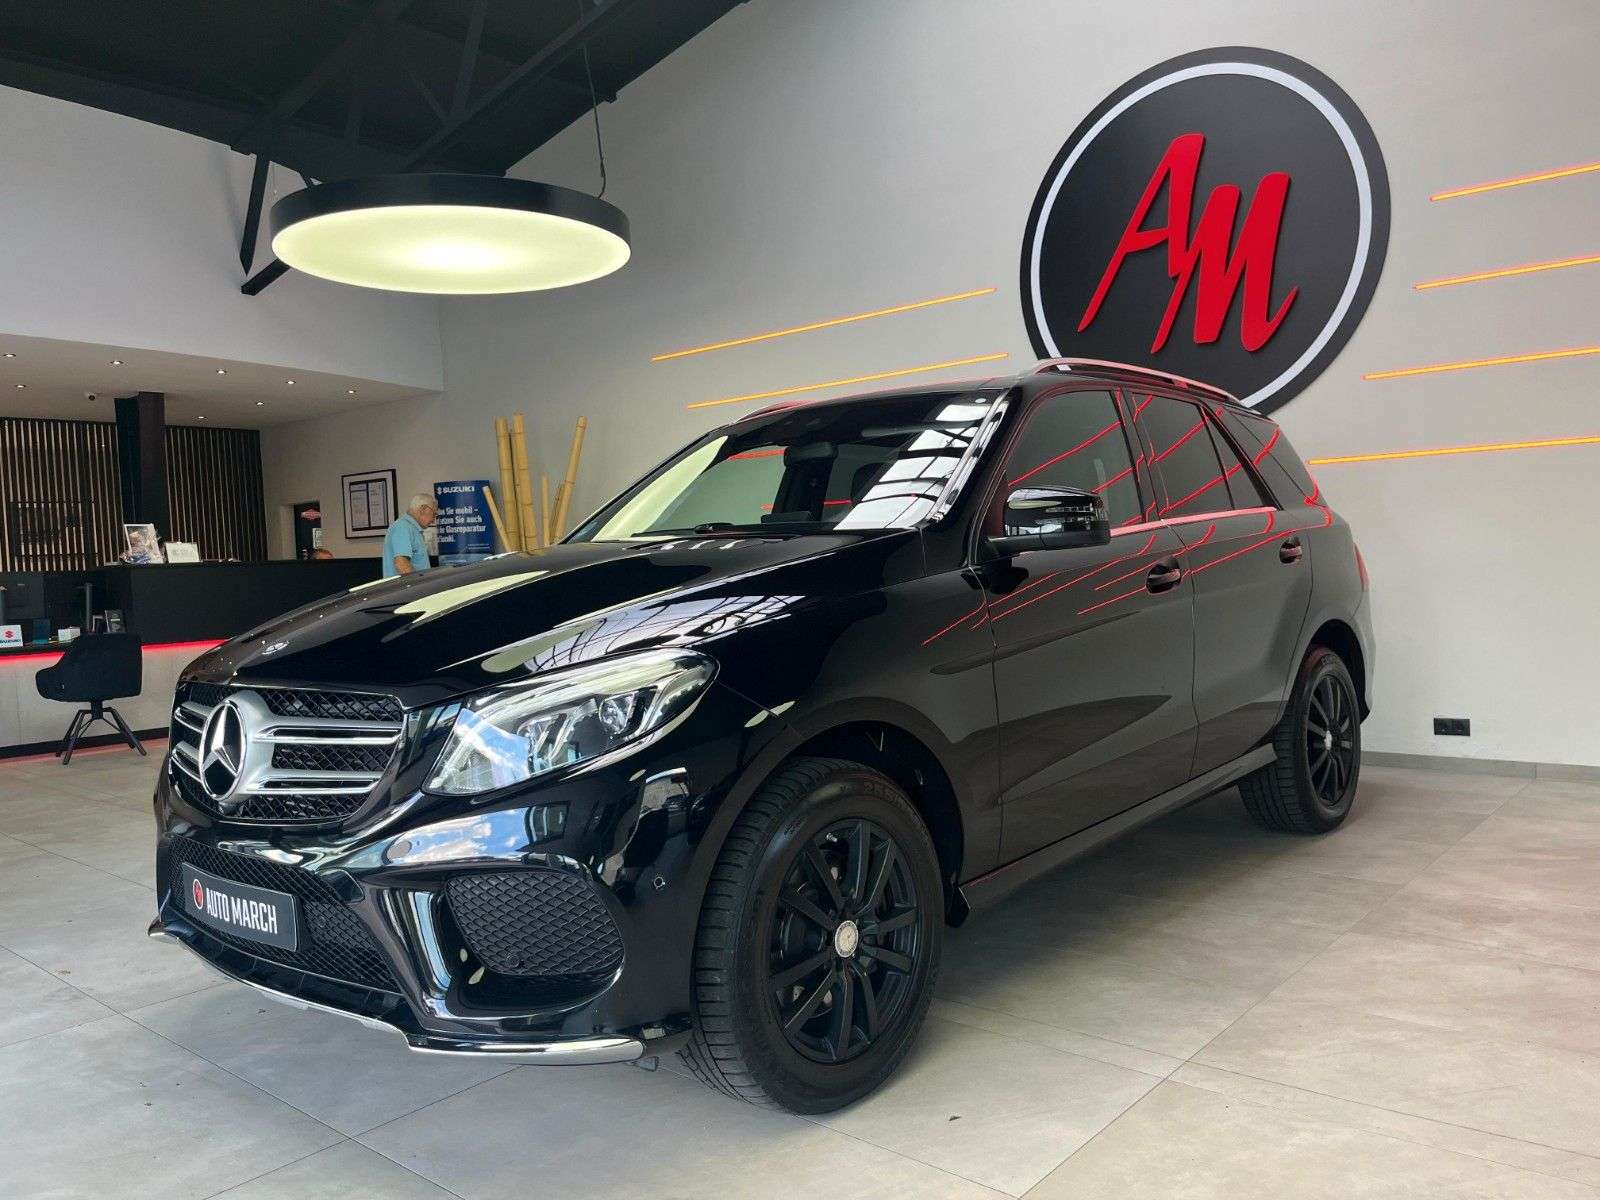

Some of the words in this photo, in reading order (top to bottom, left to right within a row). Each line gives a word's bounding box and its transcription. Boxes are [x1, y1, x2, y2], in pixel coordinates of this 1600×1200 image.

[1077, 132, 1299, 354] AM
[206, 888, 230, 922] AUTO
[231, 896, 277, 935] MARCH
